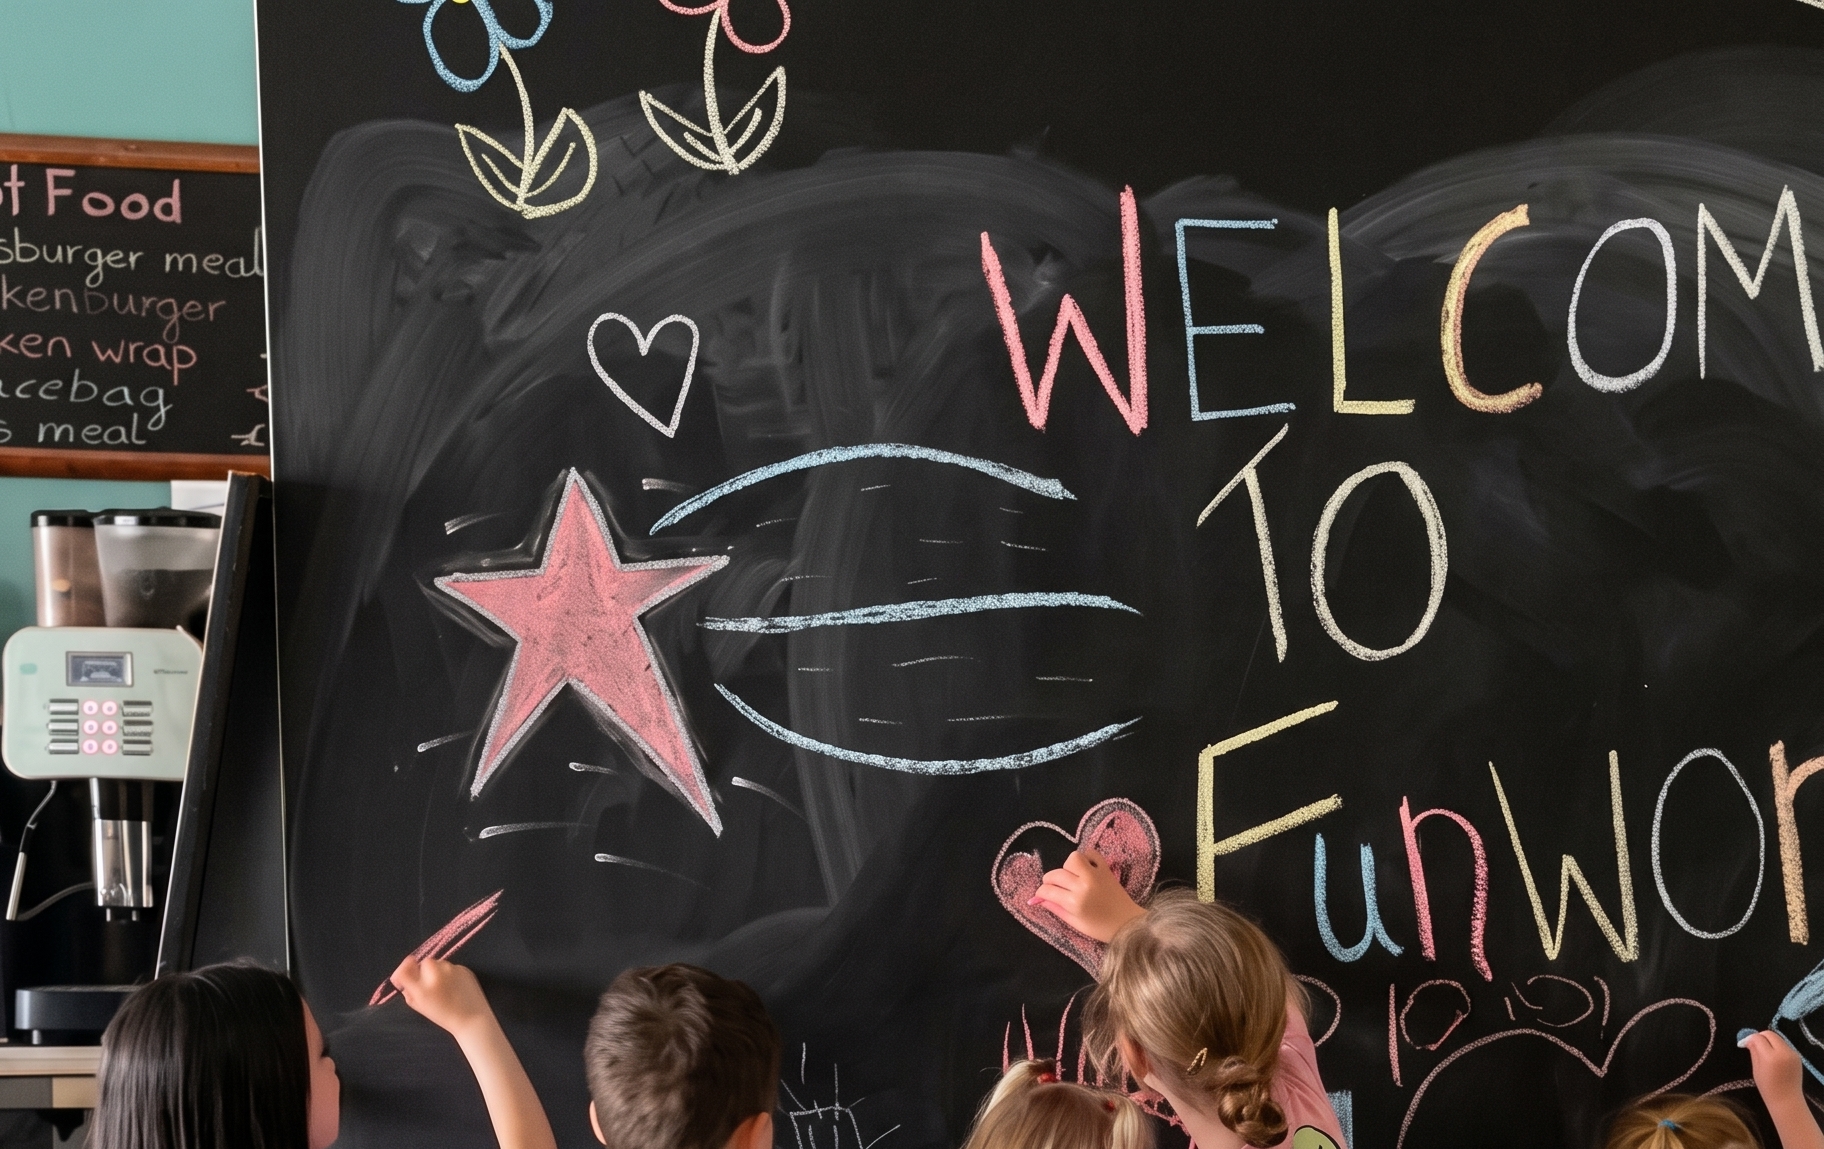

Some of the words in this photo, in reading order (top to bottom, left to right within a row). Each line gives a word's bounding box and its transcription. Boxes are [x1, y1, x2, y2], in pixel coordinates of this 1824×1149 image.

[45, 168, 182, 224] Food
[165, 225, 266, 278] meal
[2, 273, 227, 344] kenburger
[979, 183, 1824, 437] WELCOM
[92, 339, 197, 387] wrap
[0, 368, 173, 431] cebag
[38, 412, 147, 445] meal
[1196, 422, 1449, 663] TO
